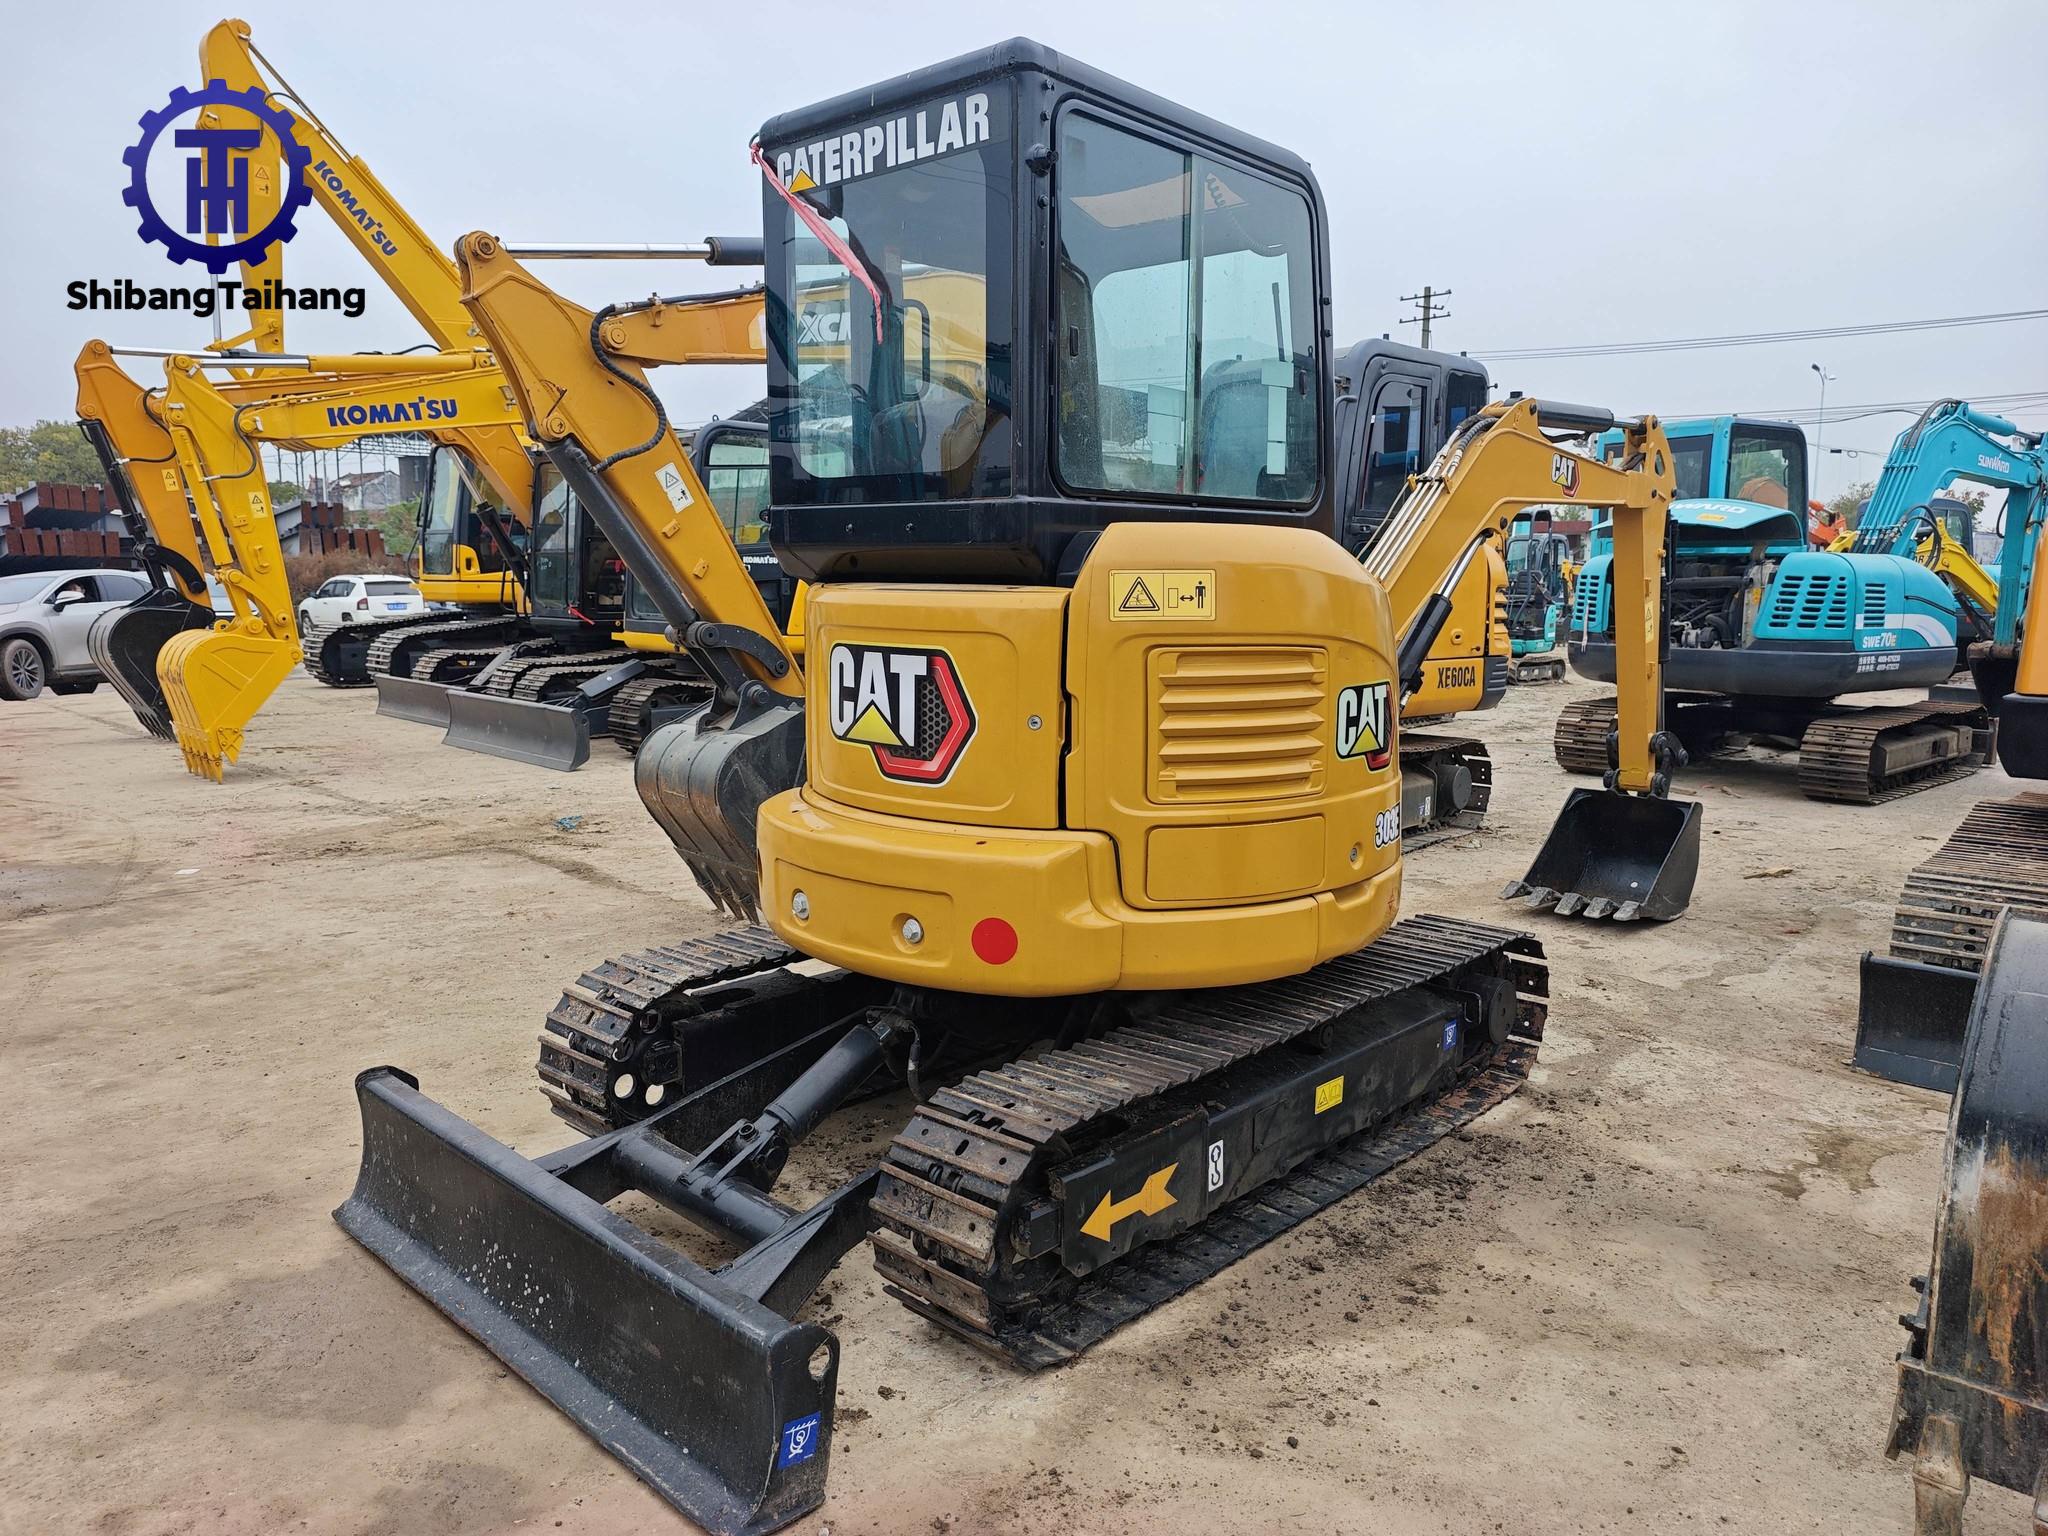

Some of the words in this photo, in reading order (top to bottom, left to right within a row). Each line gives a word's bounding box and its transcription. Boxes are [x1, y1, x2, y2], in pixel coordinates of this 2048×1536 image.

[777, 93, 990, 190] CATERPILLAR
[313, 160, 398, 256] KOMATSU
[326, 396, 459, 428] KOMATSU
[1552, 453, 1576, 487] CAT
[1977, 453, 2010, 474] SUNWARD
[1669, 503, 1747, 514] WARD
[742, 555, 779, 565] KOMATSU
[1862, 632, 1897, 649] SWE70E
[1437, 665, 1476, 689] XE60CA
[830, 645, 928, 748] CAT
[1337, 684, 1388, 757] CAT
